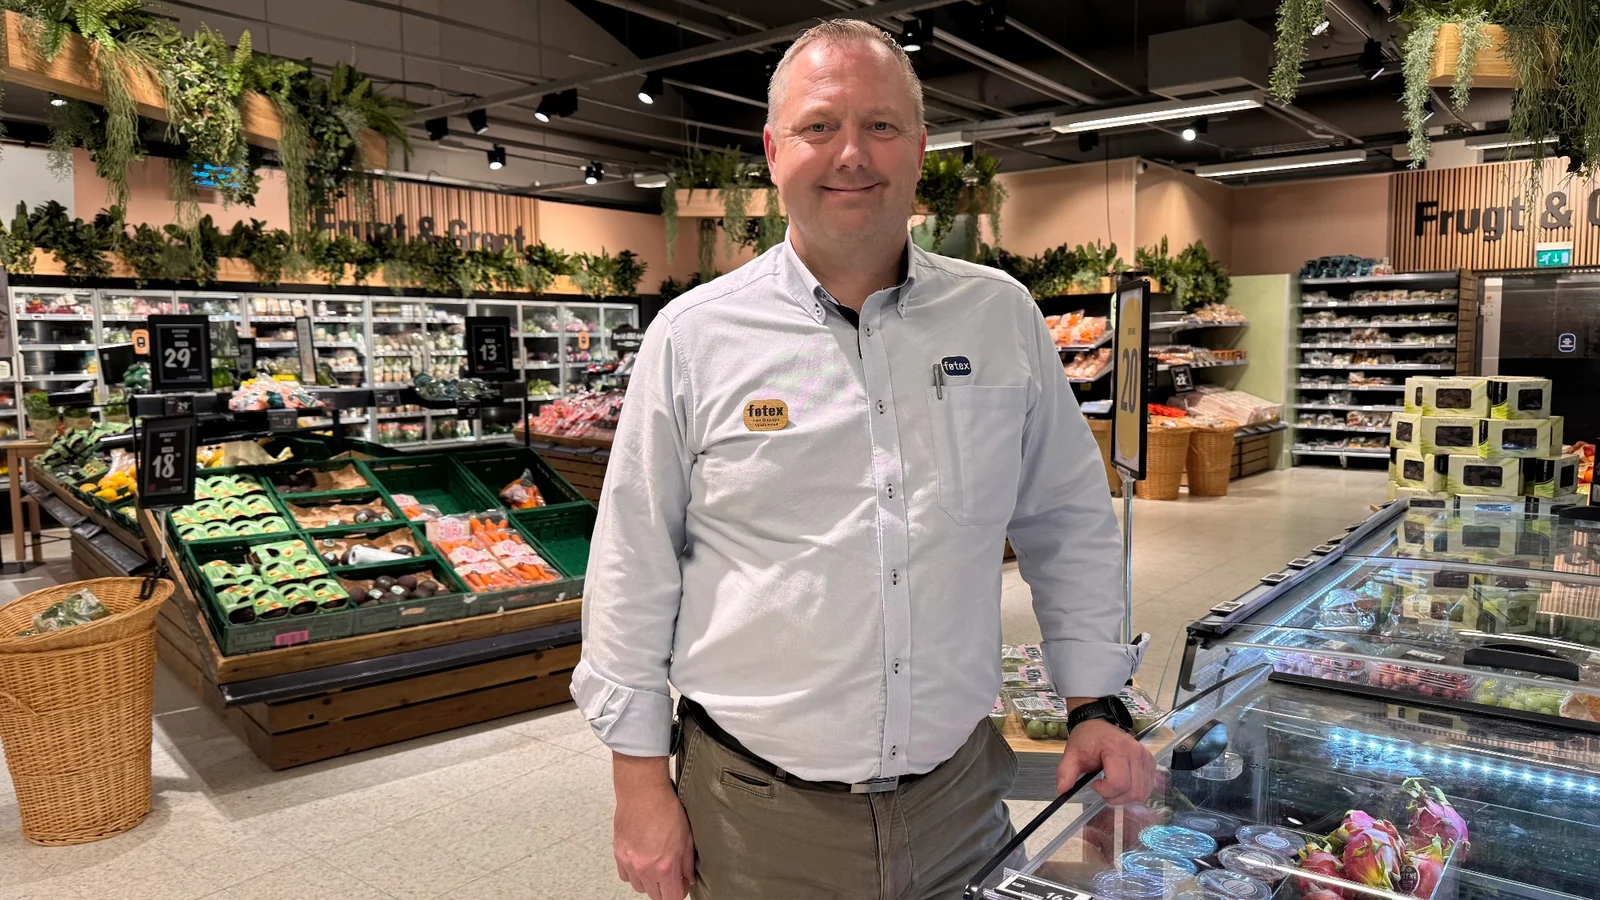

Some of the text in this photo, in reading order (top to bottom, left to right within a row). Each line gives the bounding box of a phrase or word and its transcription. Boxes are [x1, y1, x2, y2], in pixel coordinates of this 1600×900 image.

[1415, 196, 1526, 242] Frugt
[1540, 191, 1574, 230] &
[164, 347, 191, 369] 29
[479, 344, 498, 361] 13
[1121, 347, 1138, 414] 20
[1175, 376, 1187, 386] 22
[747, 404, 784, 417] føtex
[151, 453, 176, 479] 18
